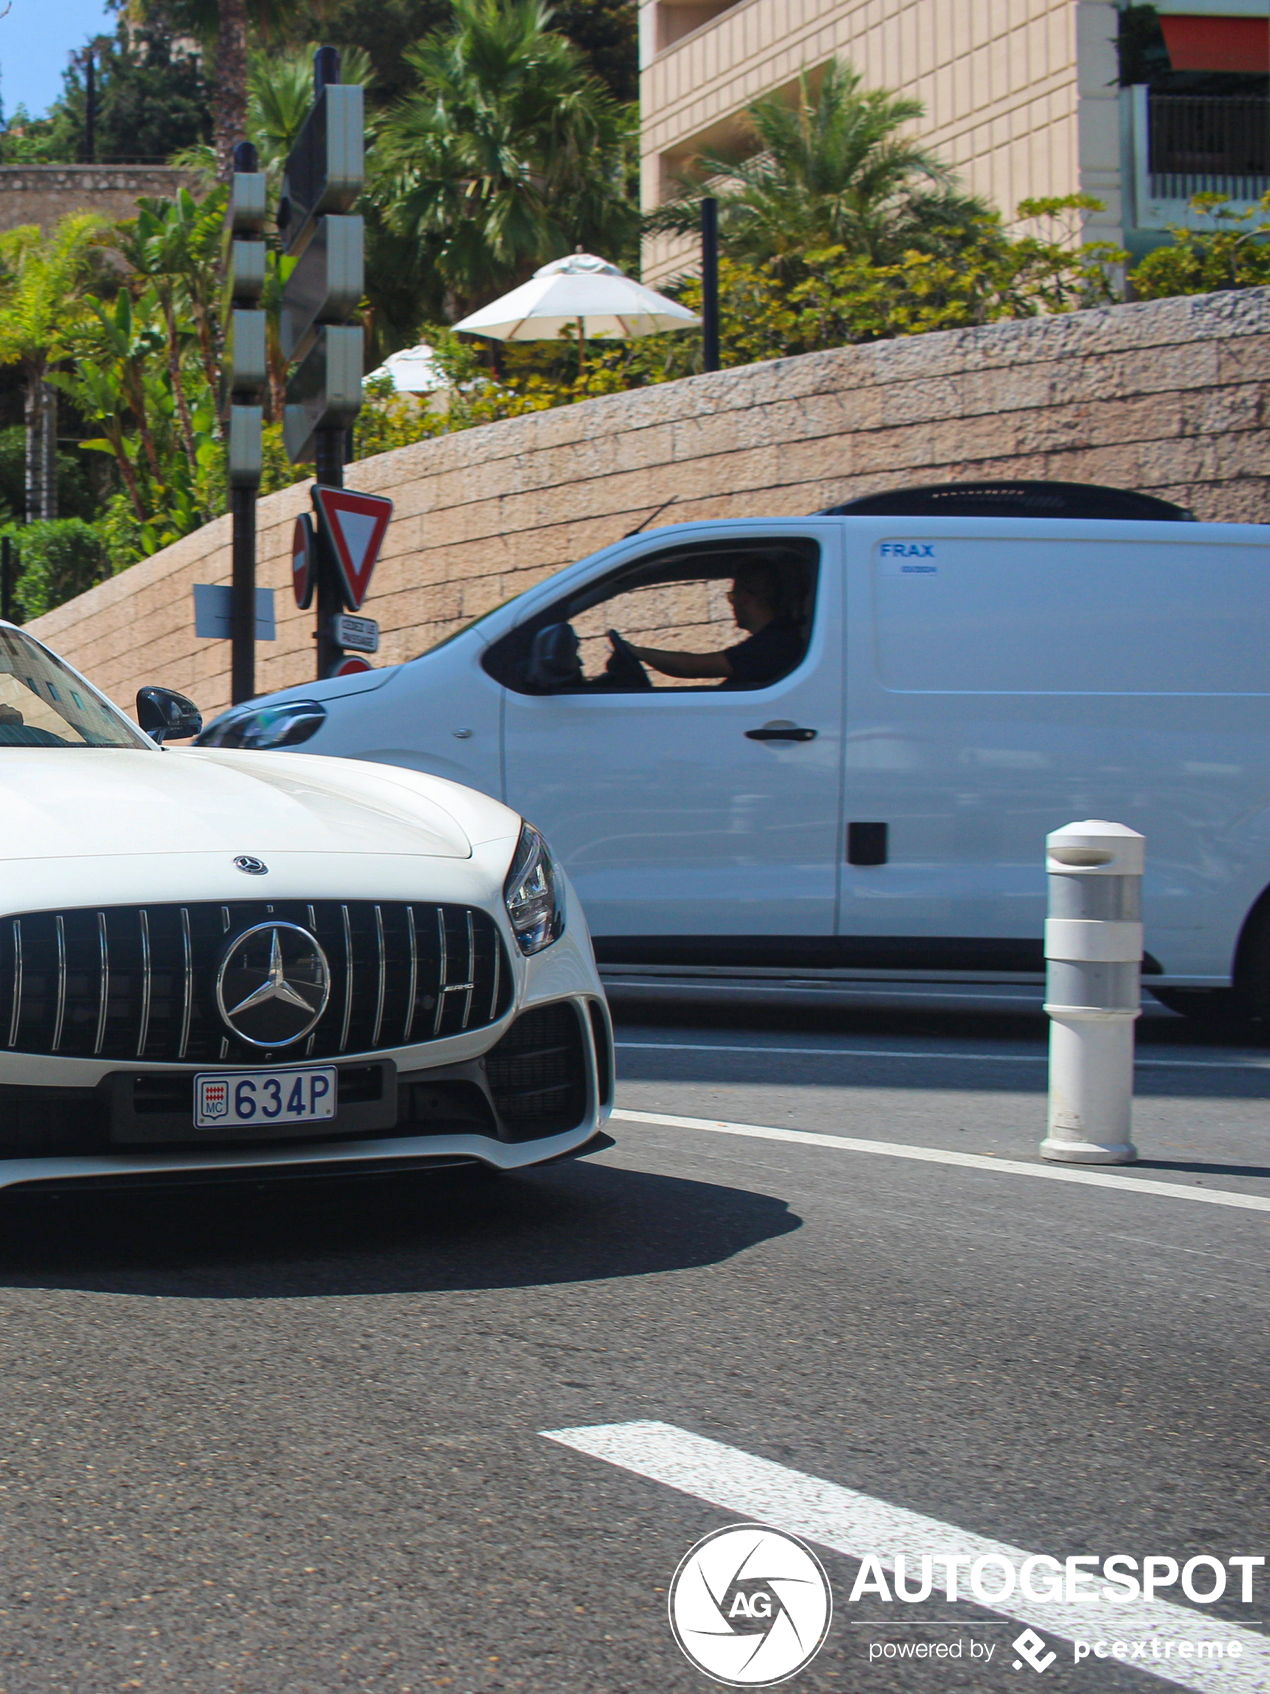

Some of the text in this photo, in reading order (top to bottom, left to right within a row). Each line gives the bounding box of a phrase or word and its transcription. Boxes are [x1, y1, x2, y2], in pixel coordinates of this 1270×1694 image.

[880, 544, 936, 557] FRAX
[206, 1075, 329, 1119] MC 634P
